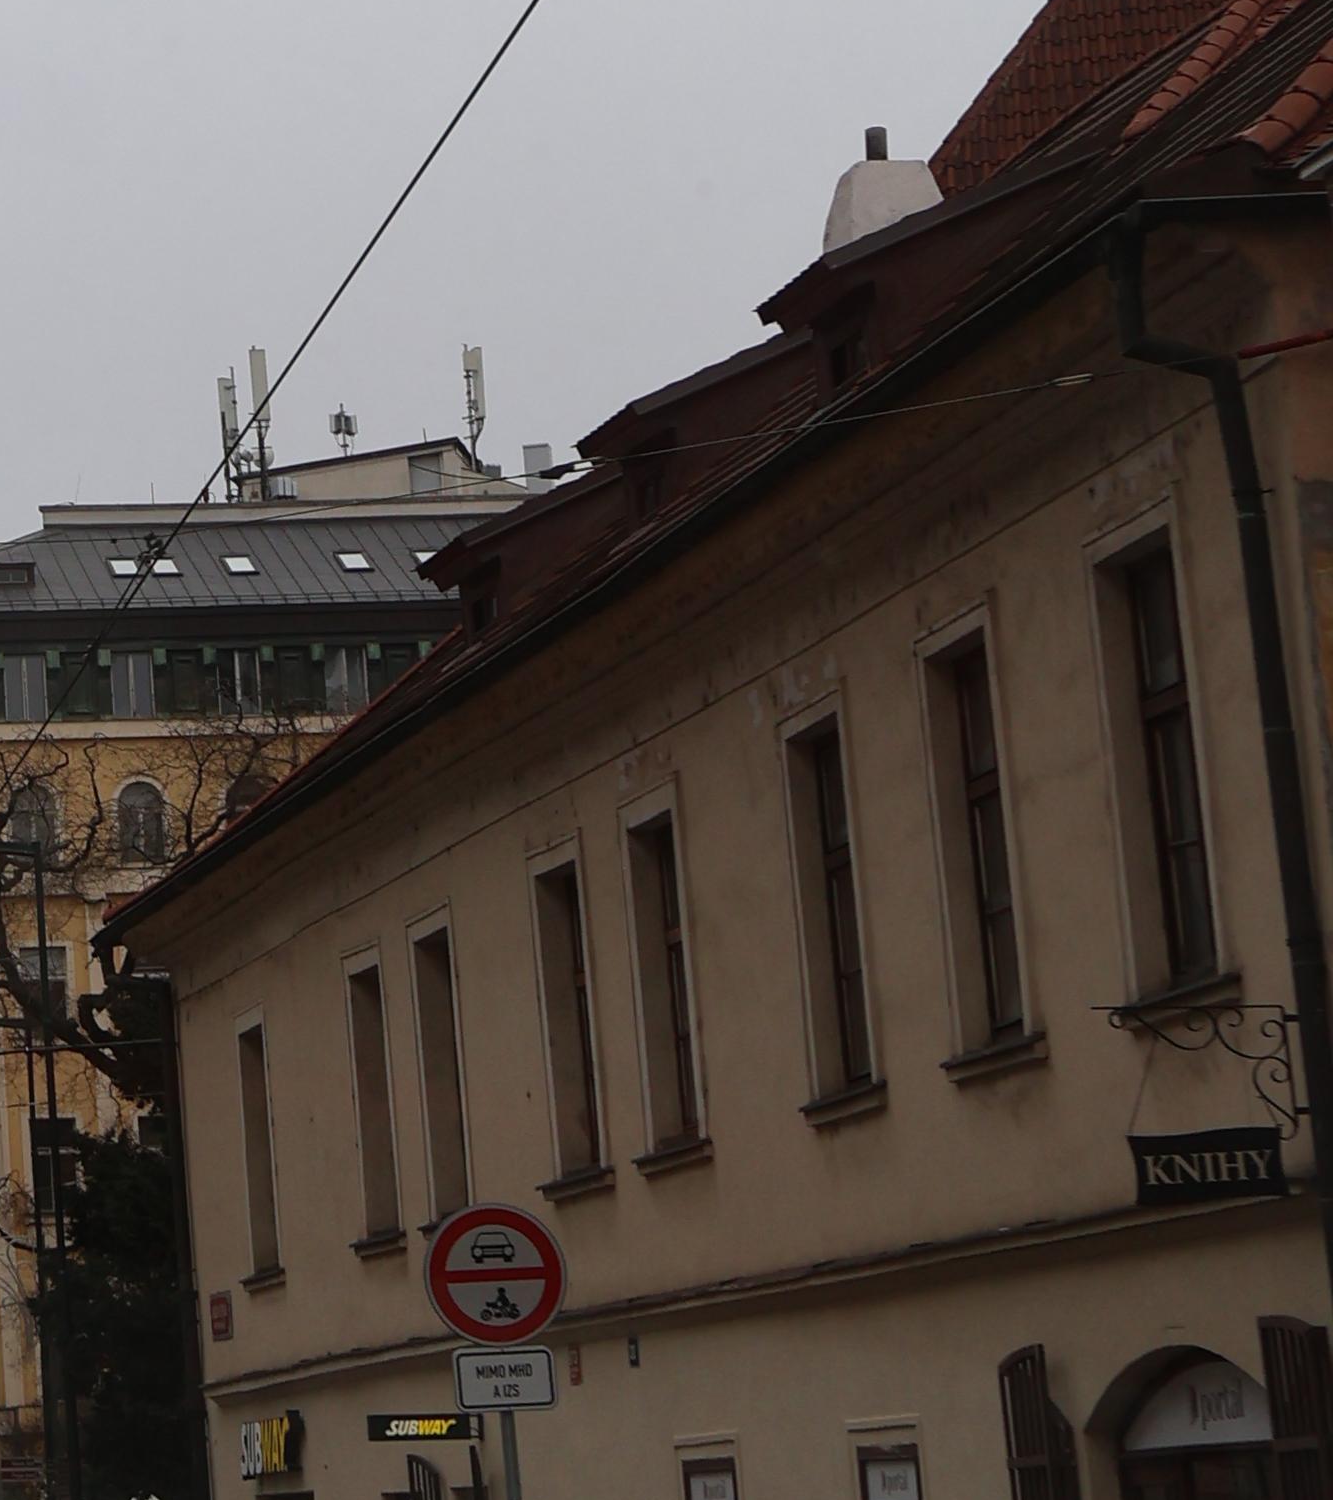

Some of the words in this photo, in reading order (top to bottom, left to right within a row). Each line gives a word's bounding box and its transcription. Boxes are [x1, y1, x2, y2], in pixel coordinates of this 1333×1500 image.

[1143, 1149, 1273, 1185] KNIHY
[475, 1364, 506, 1379] MIMO
[509, 1363, 533, 1377] MHD
[493, 1384, 501, 1398] A
[1200, 1379, 1245, 1431] portal
[385, 1418, 457, 1437] SUBWAY
[240, 1416, 289, 1475] SUBWAY
